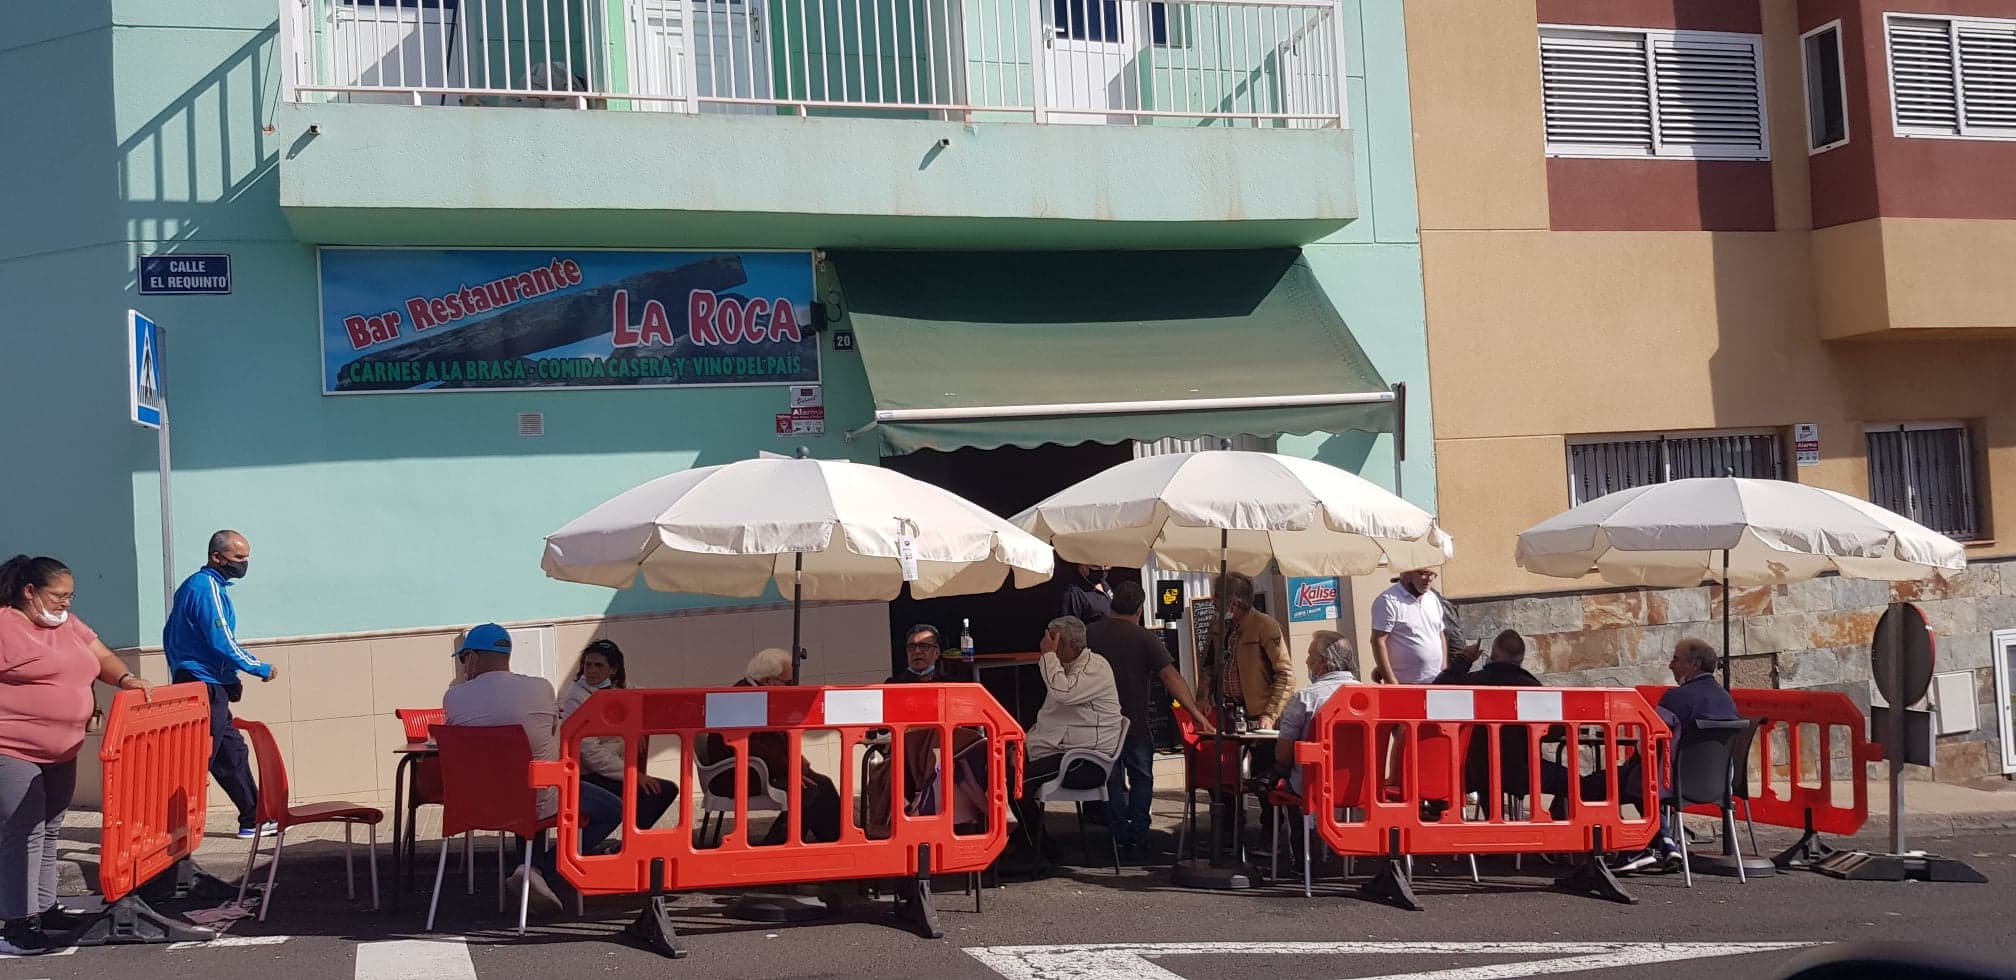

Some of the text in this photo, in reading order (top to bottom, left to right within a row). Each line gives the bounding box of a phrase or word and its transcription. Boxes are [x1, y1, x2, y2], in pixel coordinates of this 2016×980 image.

[169, 260, 206, 273] CALLE
[150, 276, 227, 289] EL REQUINTO
[344, 257, 582, 350] Bar Restaurante
[612, 289, 801, 347] LA ROCA
[836, 335, 851, 347] 20
[349, 360, 422, 382] CARNES
[424, 360, 440, 381] A
[440, 359, 465, 381] LA
[465, 358, 526, 380] BRASA
[538, 357, 607, 380] COMIDA
[607, 356, 673, 378] CASERA
[674, 356, 687, 377] Y
[692, 355, 735, 377] VINO
[736, 355, 766, 376] DEL
[766, 352, 801, 375] PAÍS
[1298, 582, 1337, 607] Kalise
